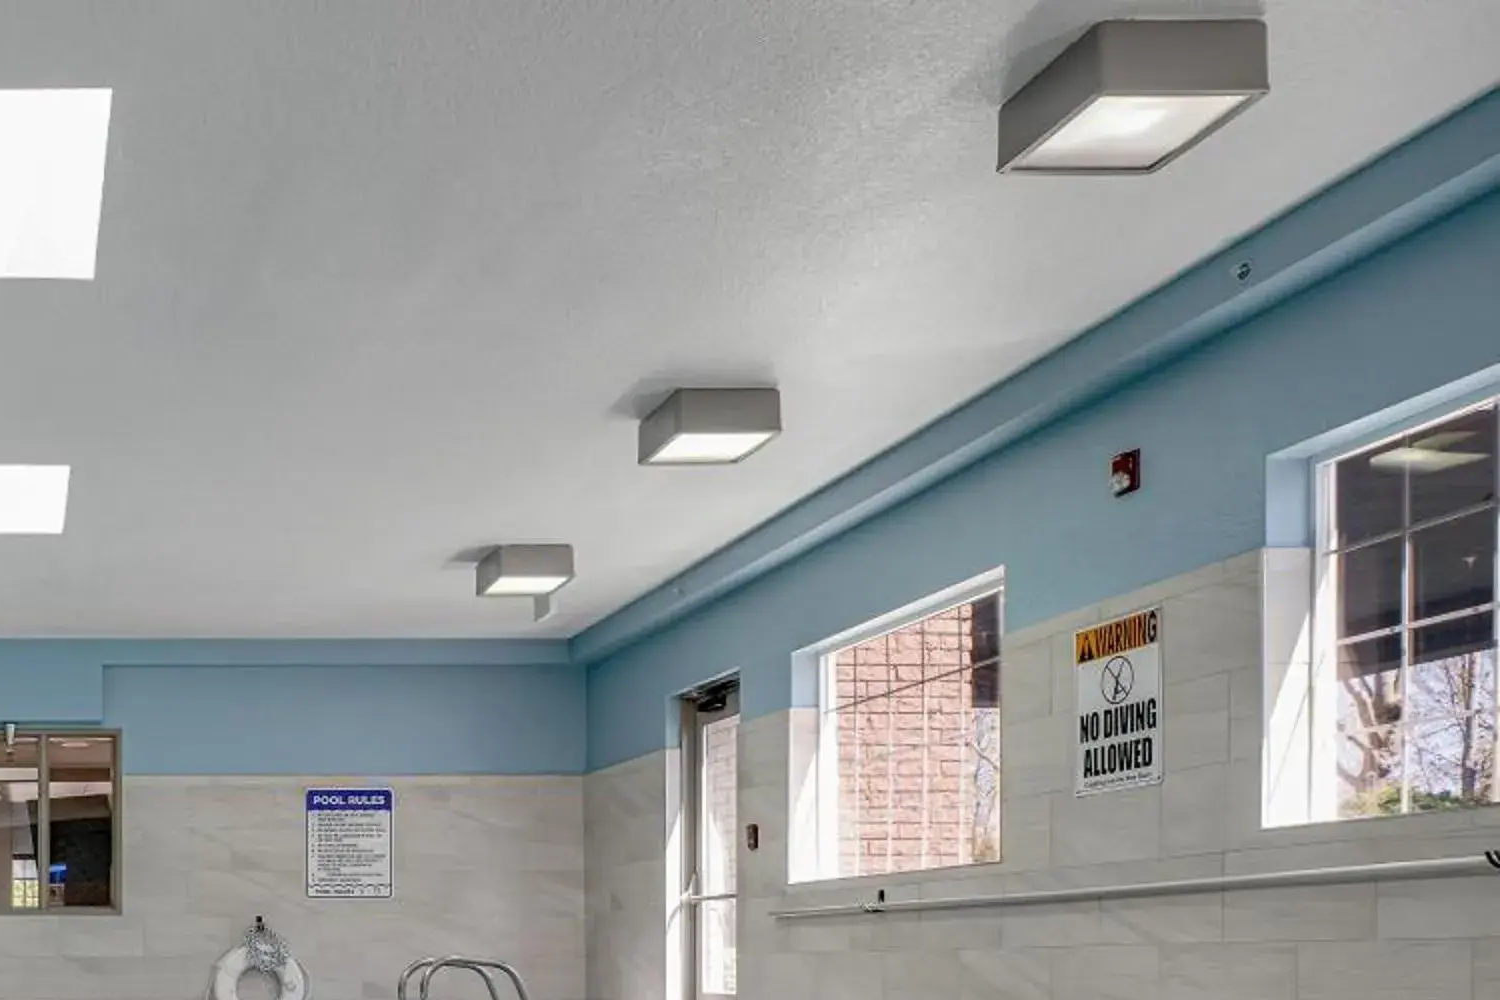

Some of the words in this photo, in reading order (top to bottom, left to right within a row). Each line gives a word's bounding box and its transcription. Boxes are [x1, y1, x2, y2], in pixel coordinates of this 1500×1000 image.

[1094, 610, 1158, 659] WARNING
[1079, 711, 1099, 744] NO
[1103, 697, 1157, 739] DIVING
[1083, 736, 1153, 779] ALLOWED
[313, 795, 345, 805] POOL
[348, 795, 385, 805] RULES
